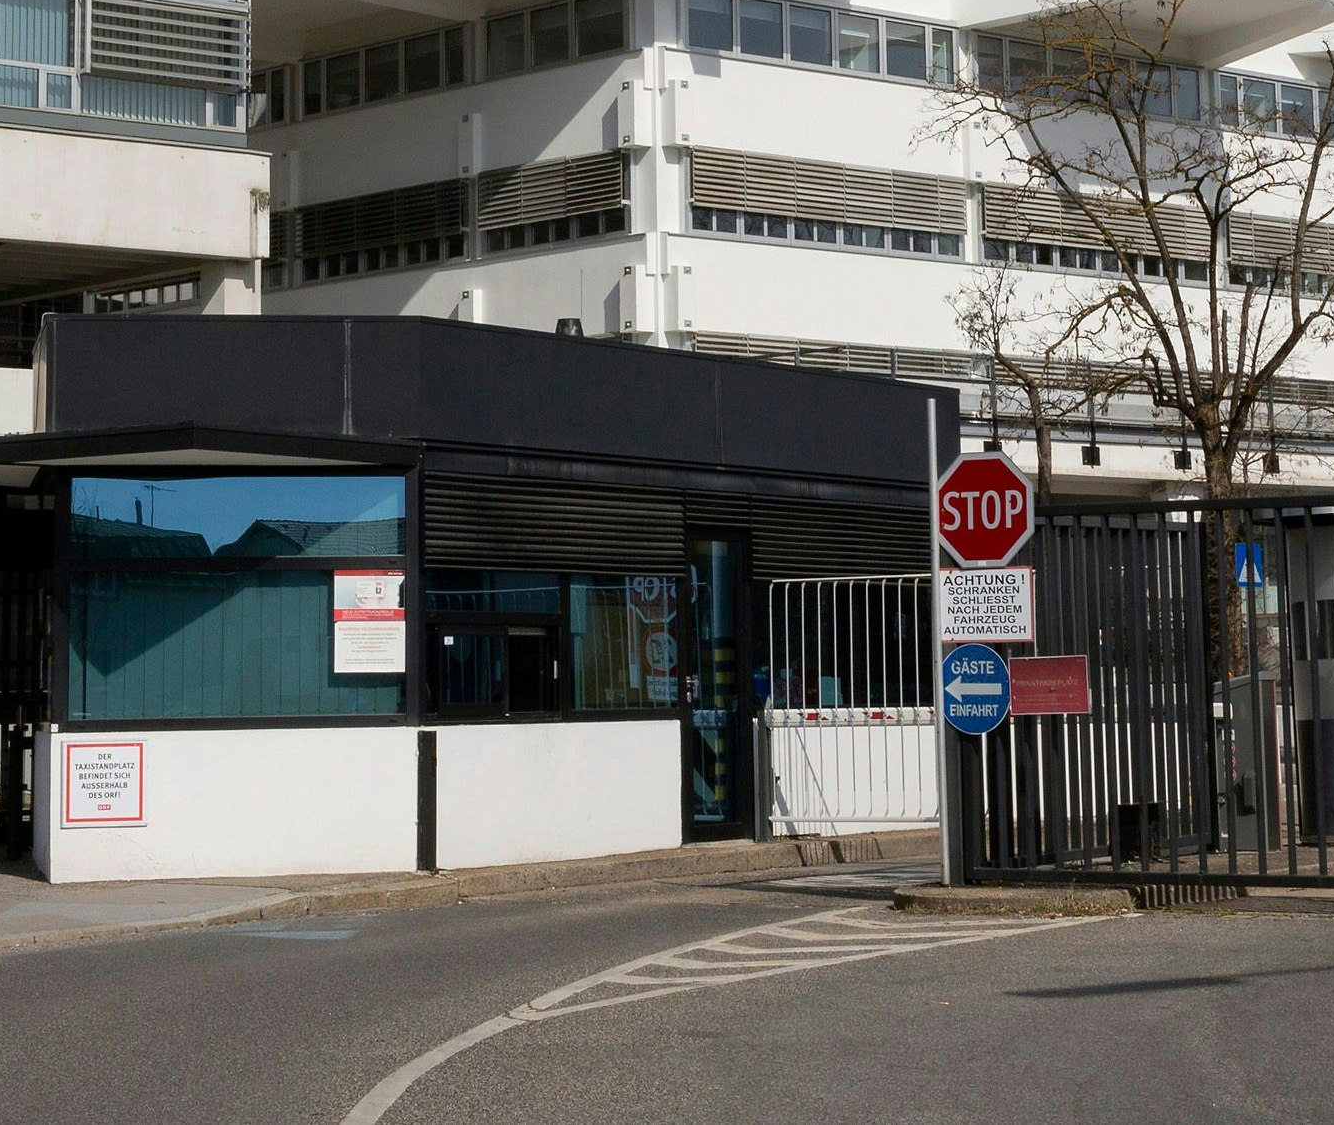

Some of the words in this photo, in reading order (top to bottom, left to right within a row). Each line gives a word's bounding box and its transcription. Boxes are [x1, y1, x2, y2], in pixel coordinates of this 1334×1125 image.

[943, 489, 1023, 531] STOP
[943, 574, 1016, 586] ACHTUNG
[948, 586, 1020, 595] SCHRANKEN
[952, 595, 1016, 605] SCHLIESST
[947, 606, 980, 615] NACH
[983, 605, 1022, 614] JEDEM
[953, 615, 1016, 624] FAHRZEUG
[943, 625, 1027, 635] AUTOMATISCH
[951, 657, 995, 675] GÄSTE
[949, 704, 999, 717] EINFAHRT
[75, 762, 135, 770] TAXISTANDPLATZ
[104, 791, 121, 799] ORF!
